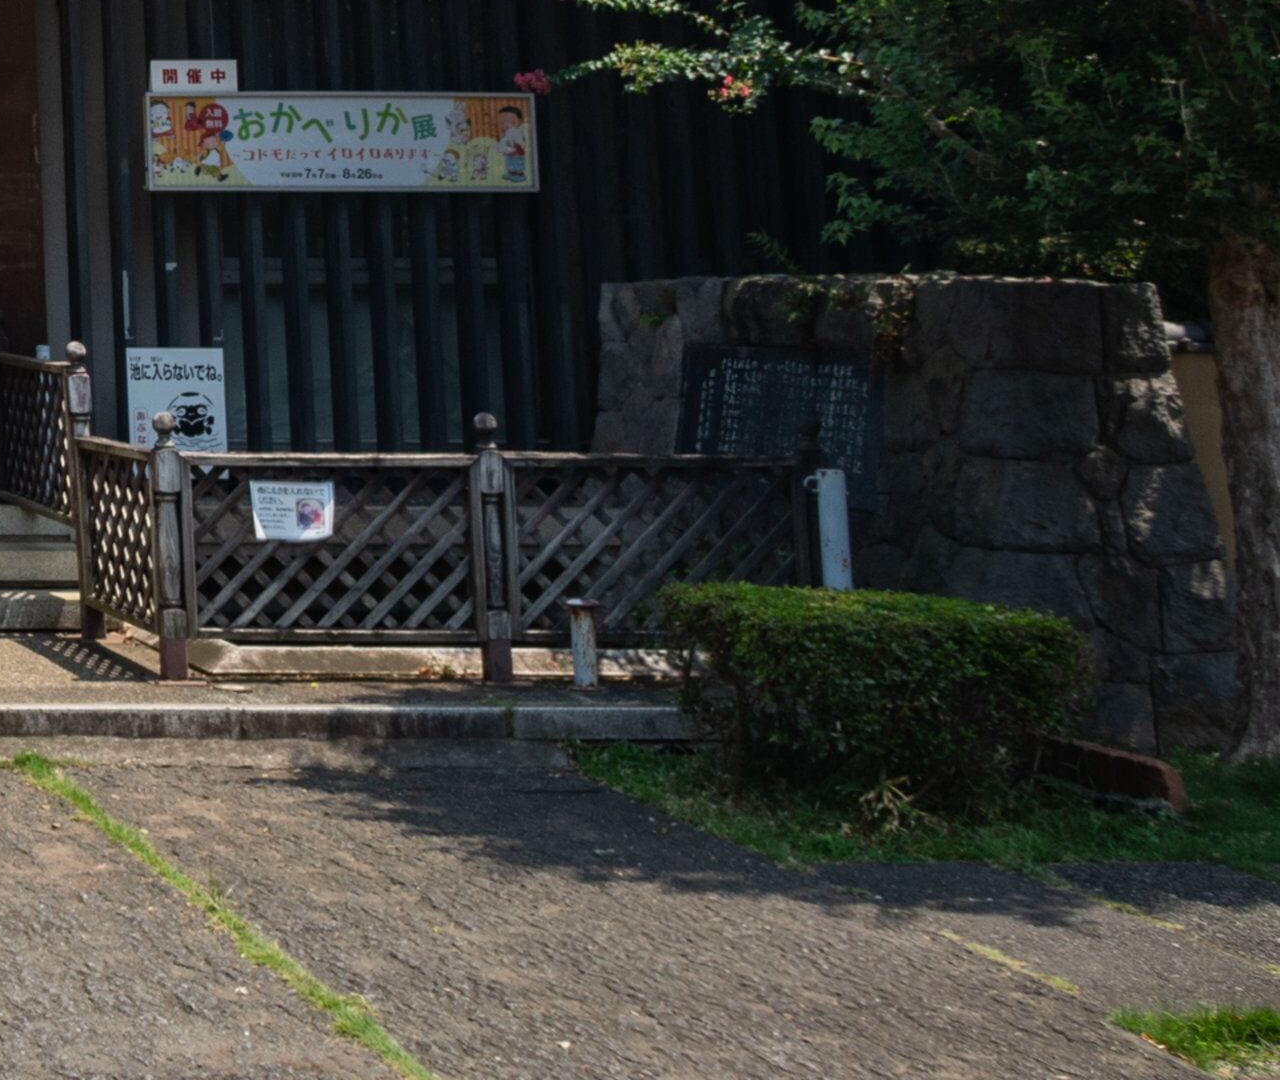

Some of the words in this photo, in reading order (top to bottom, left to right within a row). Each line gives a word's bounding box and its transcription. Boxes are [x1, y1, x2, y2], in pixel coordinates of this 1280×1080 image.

[162, 68, 227, 85] 開催中
[234, 102, 438, 142] おかべりか展
[130, 363, 223, 381] 池に入らないでね。
